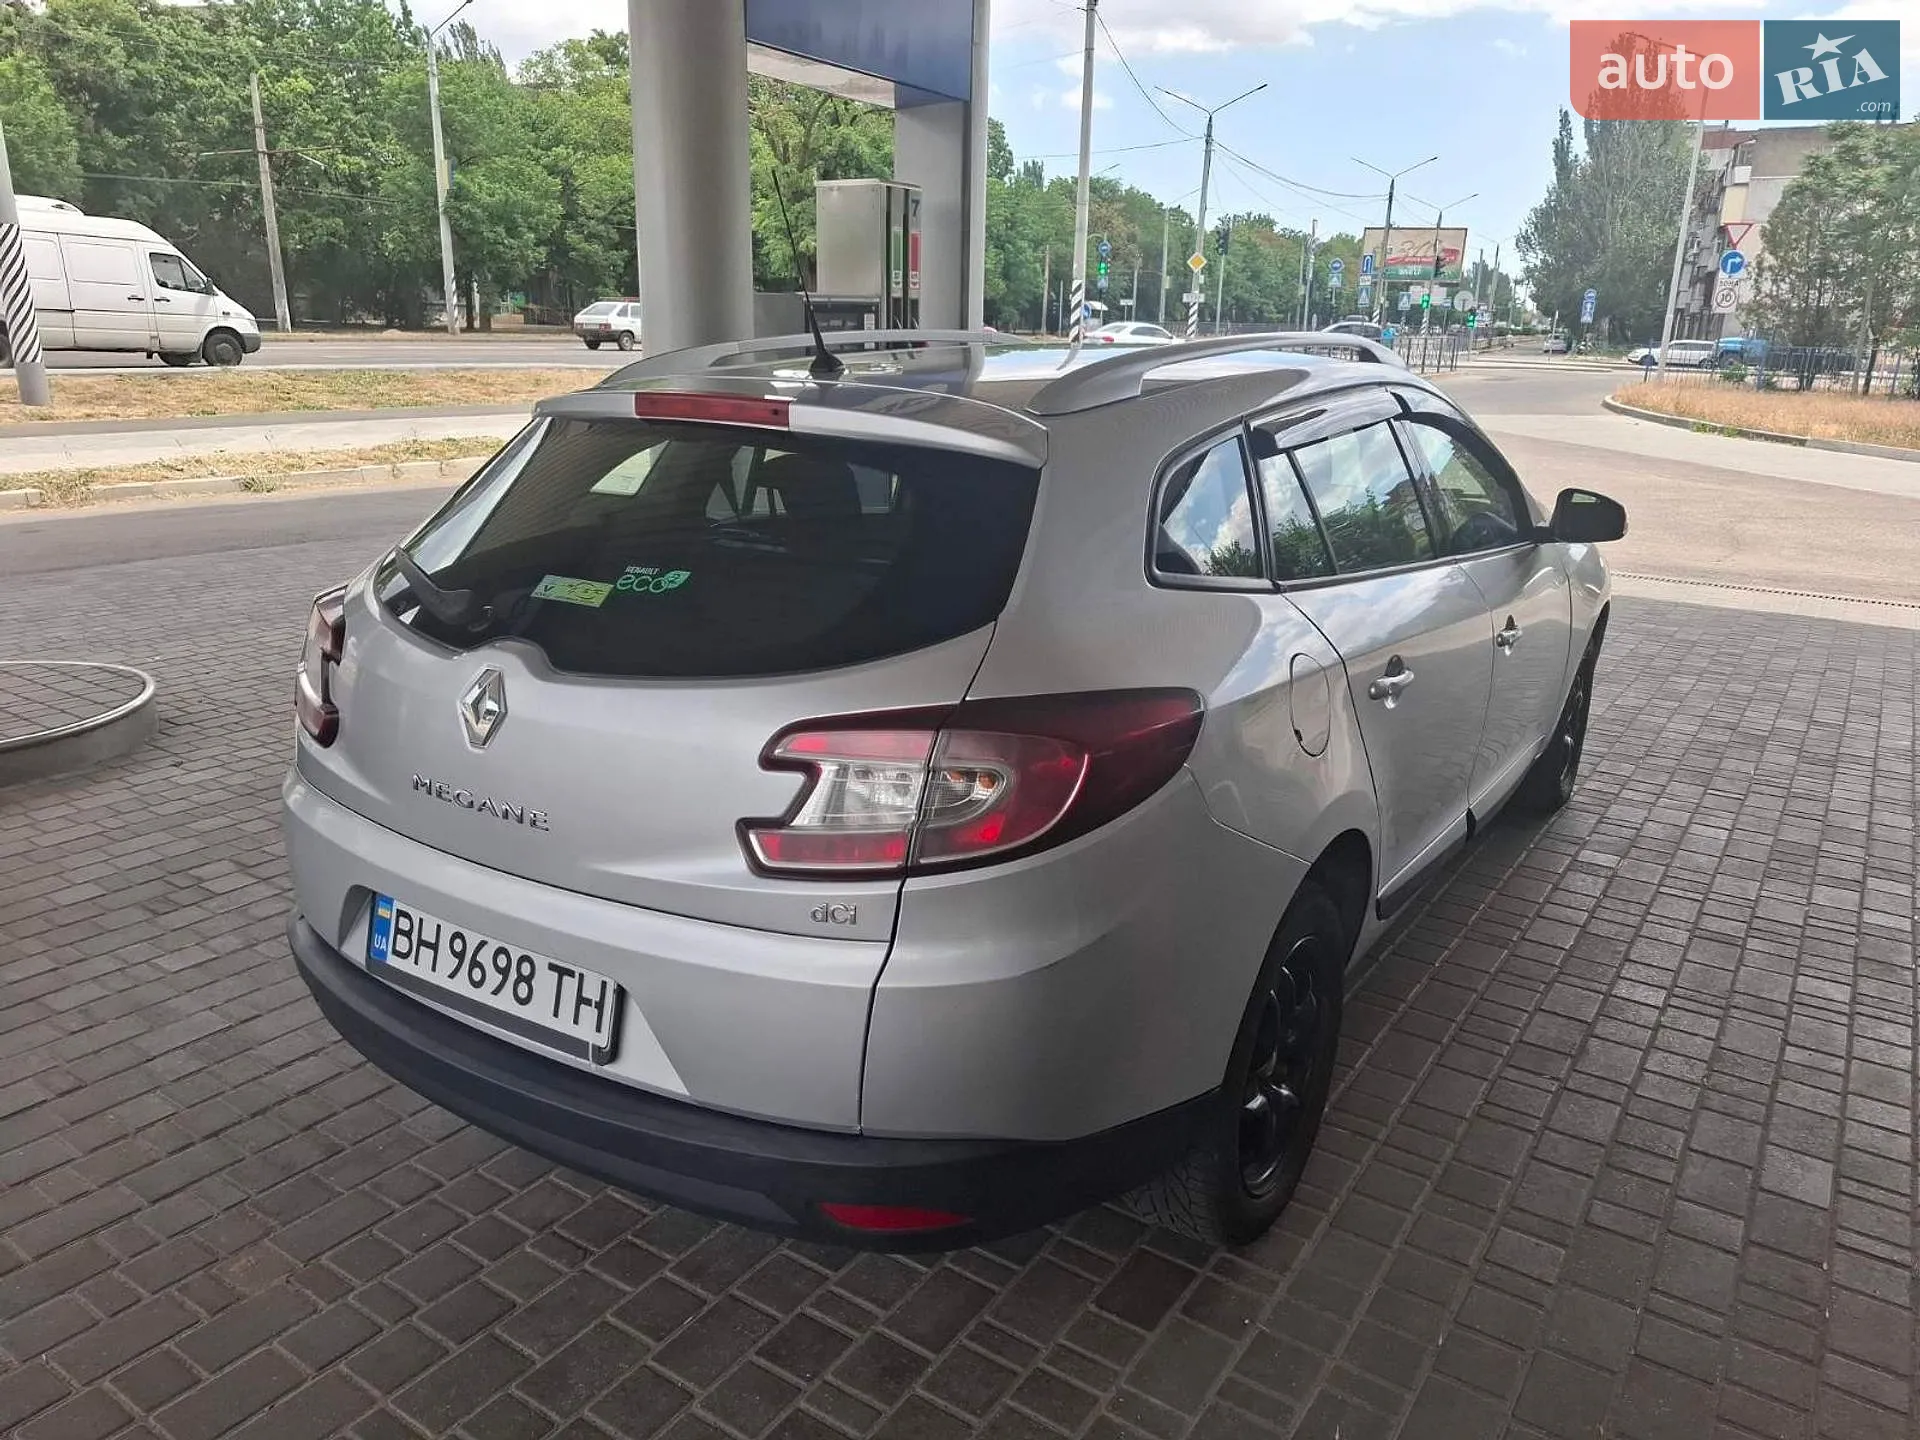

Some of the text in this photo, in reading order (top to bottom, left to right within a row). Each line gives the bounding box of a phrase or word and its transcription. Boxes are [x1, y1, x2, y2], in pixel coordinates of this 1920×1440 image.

[911, 199, 920, 217] 7
[412, 772, 550, 832] MEGANE
[810, 902, 857, 926] dCi
[374, 933, 388, 951] UA
[391, 907, 608, 1034] BH 9698 TH
